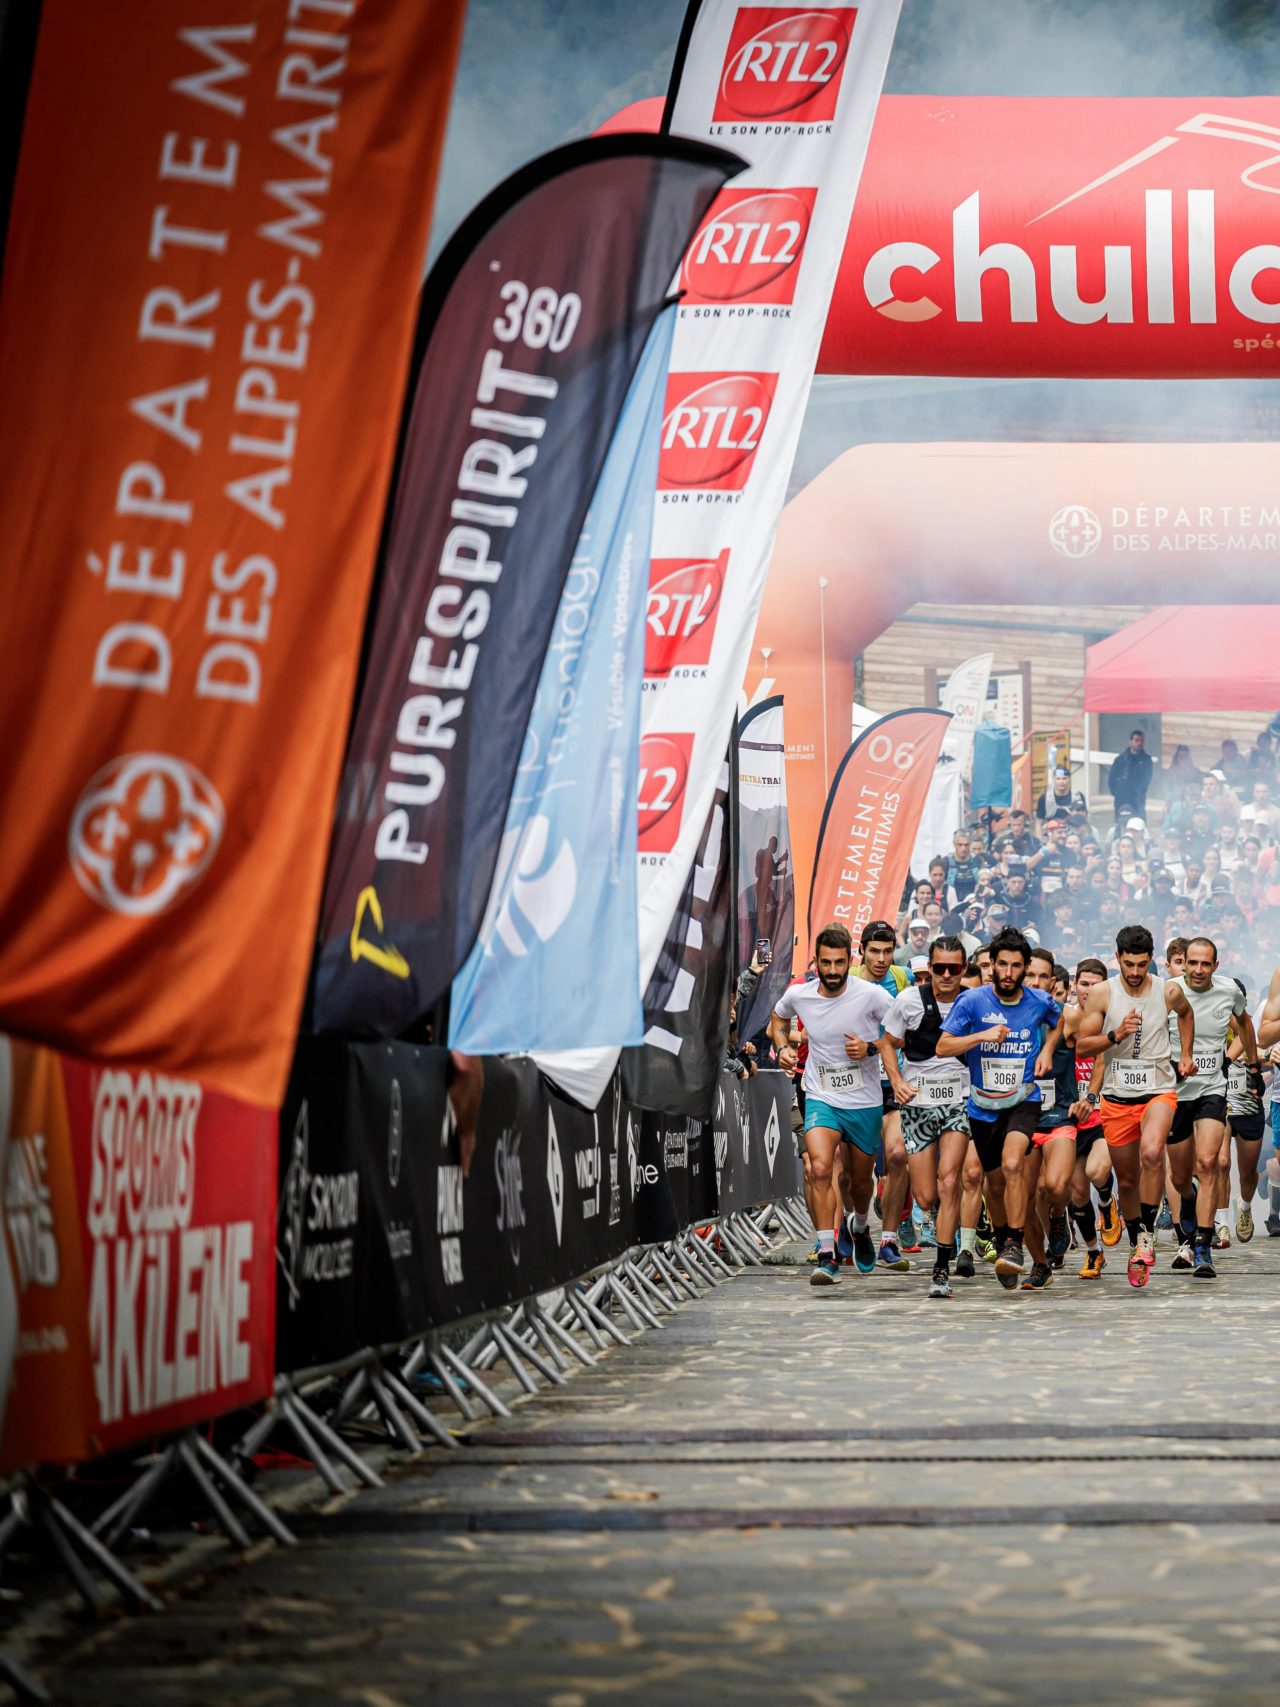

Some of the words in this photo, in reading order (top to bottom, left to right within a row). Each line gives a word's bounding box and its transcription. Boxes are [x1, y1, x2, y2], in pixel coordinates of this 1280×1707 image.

[732, 40, 839, 84] RTL2
[709, 125, 724, 135] LE
[730, 125, 758, 136] SON
[765, 123, 833, 136] POP-ROCK
[694, 219, 801, 265] RTL2
[493, 279, 581, 353] 360
[694, 308, 721, 318] SON
[728, 308, 792, 318] POP-ROCK
[662, 404, 763, 449] RTL2
[662, 494, 690, 503] SON
[1112, 533, 1151, 551] DES
[374, 349, 559, 864] PURESPIRIT
[196, 551, 278, 706] DES
[867, 734, 917, 770] 06
[1195, 1056, 1217, 1069] 3029
[830, 1073, 854, 1088] 3250
[994, 1072, 1017, 1085] 3068
[1124, 1072, 1147, 1085] 3084
[929, 1086, 954, 1099] 3066
